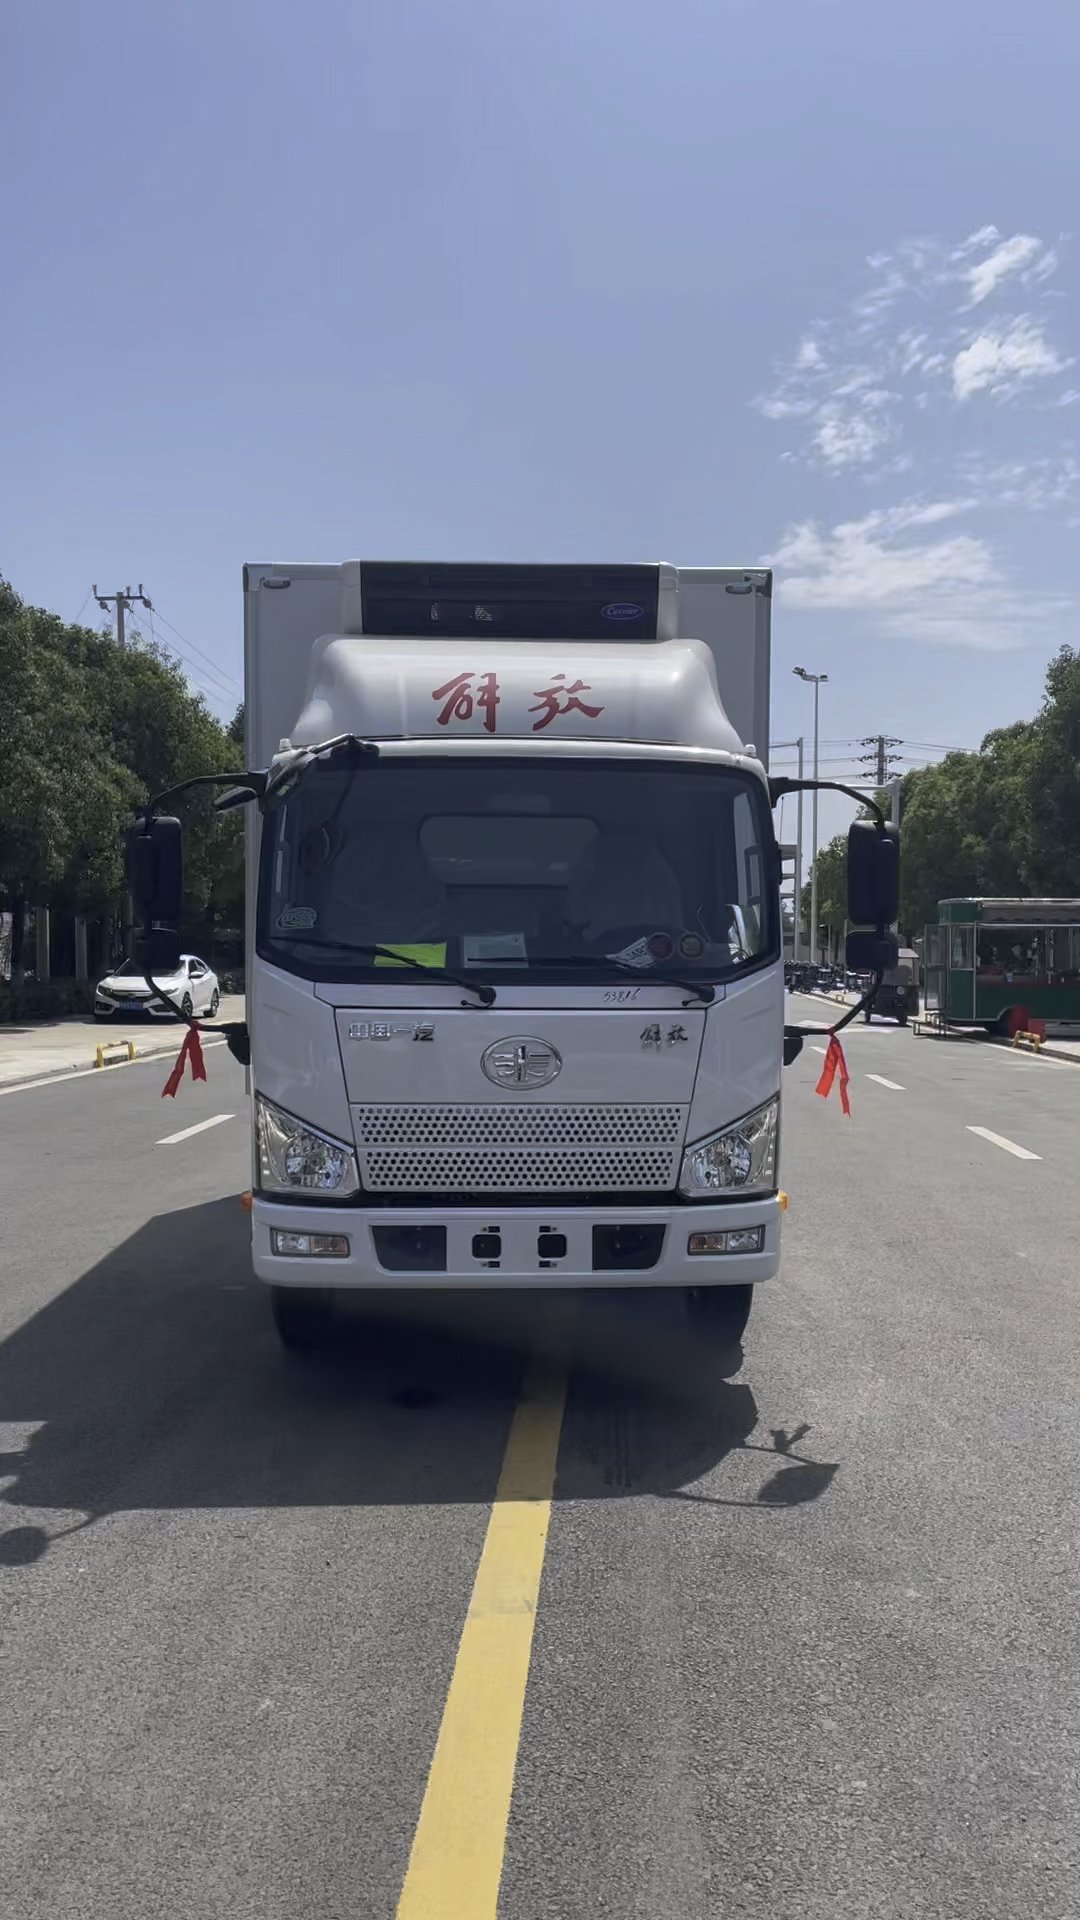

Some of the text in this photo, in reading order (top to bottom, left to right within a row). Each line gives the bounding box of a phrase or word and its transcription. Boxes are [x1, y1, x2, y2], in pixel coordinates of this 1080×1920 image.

[431, 672, 605, 733] 解放
[349, 1022, 435, 1041] 中国一汽
